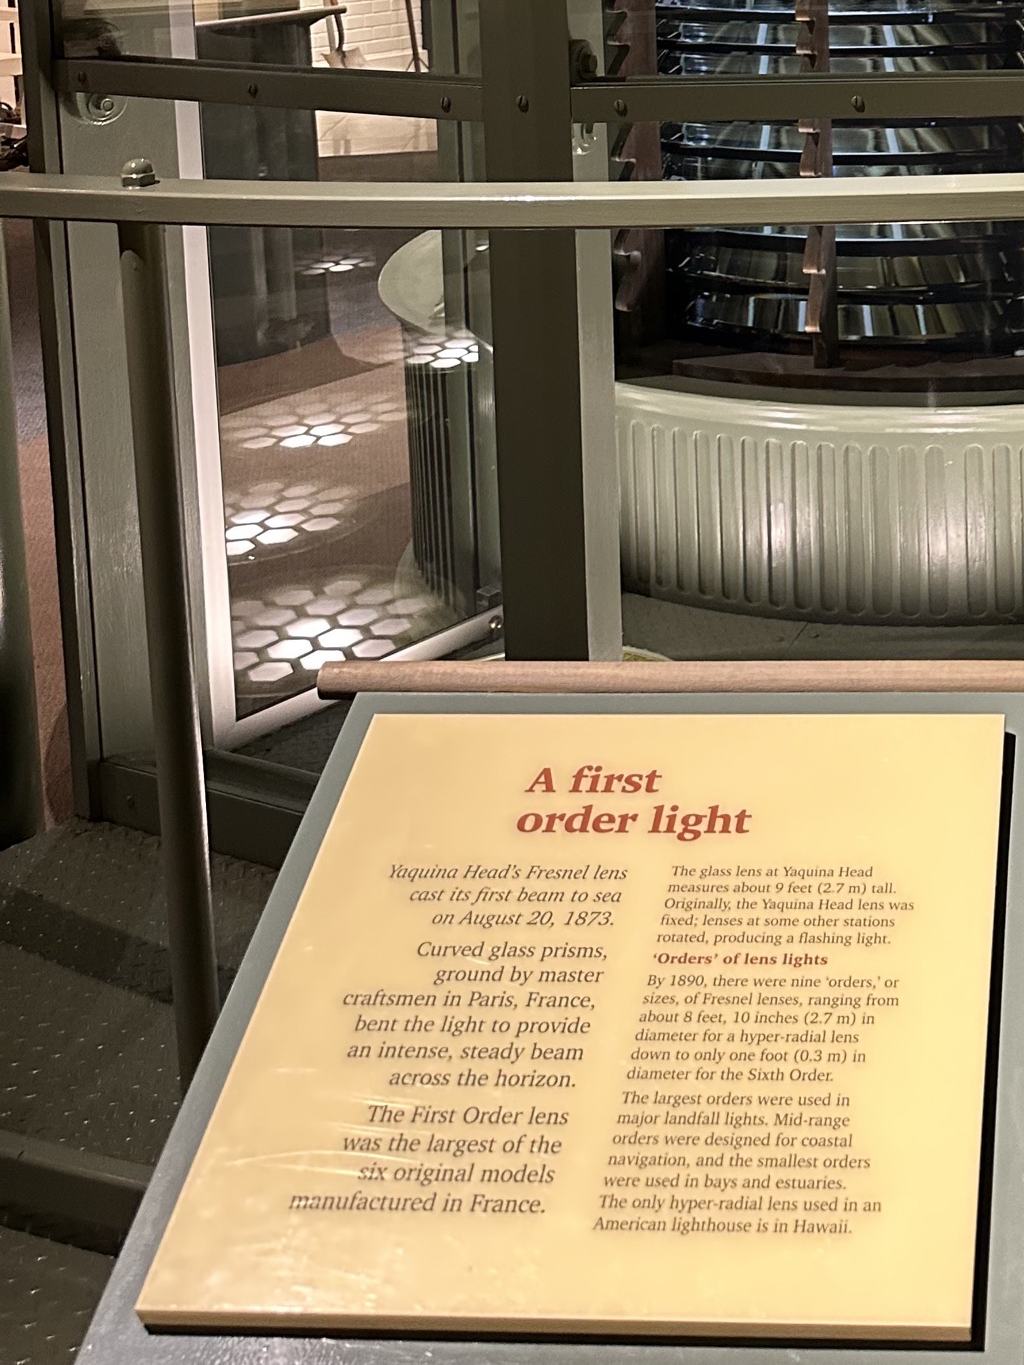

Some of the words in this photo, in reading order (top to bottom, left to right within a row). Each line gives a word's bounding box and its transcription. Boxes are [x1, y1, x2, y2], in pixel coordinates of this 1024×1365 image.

[526, 768, 556, 793] A
[568, 765, 662, 793] first
[517, 804, 638, 833] order
[648, 805, 752, 841] light
[389, 864, 458, 883] Yaquina
[526, 865, 590, 879] Fresnel
[594, 865, 628, 879] lens
[672, 865, 696, 876] The
[699, 865, 732, 879] glass
[736, 865, 762, 877] lens
[766, 868, 778, 877] at
[784, 867, 834, 879] Yaquina
[838, 866, 873, 877] Head
[410, 889, 445, 901] cast
[450, 886, 470, 902] its
[470, 886, 513, 906] first
[517, 887, 565, 903] beam
[571, 890, 589, 903] to
[593, 892, 622, 903] sea
[668, 885, 729, 893] measures
[733, 882, 770, 893] about
[776, 883, 784, 893] 9
[788, 881, 812, 893] feet
[818, 883, 844, 895] (2.7
[848, 883, 866, 895] m)
[872, 883, 896, 893] tall.
[664, 898, 731, 912] Originally,
[737, 898, 758, 909] the
[762, 899, 813, 913] Yaquina
[819, 899, 853, 910] Head
[858, 899, 884, 910] lens
[889, 902, 914, 910] was
[432, 914, 454, 925] on
[458, 911, 524, 929] August
[526, 911, 554, 929] 20,
[564, 911, 614, 926] 1873.
[660, 914, 698, 927] fixed;
[702, 915, 743, 926] lenses
[747, 917, 760, 926] at
[764, 918, 799, 927] some
[804, 915, 840, 927] other
[843, 915, 895, 927] stations
[657, 931, 708, 945] rotated,
[713, 931, 782, 946] producing
[786, 935, 794, 943] a
[799, 932, 852, 947] flashing
[857, 932, 891, 947] light.
[417, 941, 484, 957] Curved
[488, 941, 536, 961] glass
[540, 942, 607, 962] prisms,
[723, 953, 741, 964] of
[744, 953, 777, 965] lens
[782, 953, 828, 968] lights
[433, 965, 504, 985] ground
[510, 965, 534, 986] by
[538, 970, 604, 983] master
[343, 989, 436, 1007] craftsmen
[443, 990, 461, 1007] in
[468, 991, 518, 1010] Paris,
[525, 992, 594, 1011] France,
[354, 1014, 398, 1032] bent
[404, 1015, 434, 1032] the
[440, 1015, 486, 1037] light
[492, 1020, 510, 1033] to
[514, 1017, 590, 1038] provide
[347, 1045, 371, 1058] an
[378, 1041, 452, 1062] intense,
[460, 1042, 526, 1065] steady
[531, 1043, 583, 1061] beam
[389, 1073, 451, 1086] across
[457, 1068, 488, 1087] the
[494, 1069, 576, 1087] horizon.
[368, 1105, 404, 1123] The
[410, 1105, 457, 1123] First
[463, 1105, 524, 1125] Order
[528, 1106, 569, 1125] lens
[344, 1137, 382, 1154] was
[388, 1133, 420, 1152] the
[426, 1133, 496, 1158] largest
[502, 1134, 527, 1153] of
[530, 1135, 562, 1154] the
[357, 1162, 388, 1181] six
[394, 1163, 475, 1187] original
[480, 1163, 555, 1183] models
[288, 1190, 437, 1211] manufactured
[442, 1193, 462, 1212] in
[470, 1194, 545, 1213] France.
[592, 1217, 666, 1231] American
[672, 1217, 752, 1235] lighthouse
[756, 1218, 768, 1233] is
[773, 1219, 788, 1233] in
[793, 1219, 852, 1233] Hawaii.
